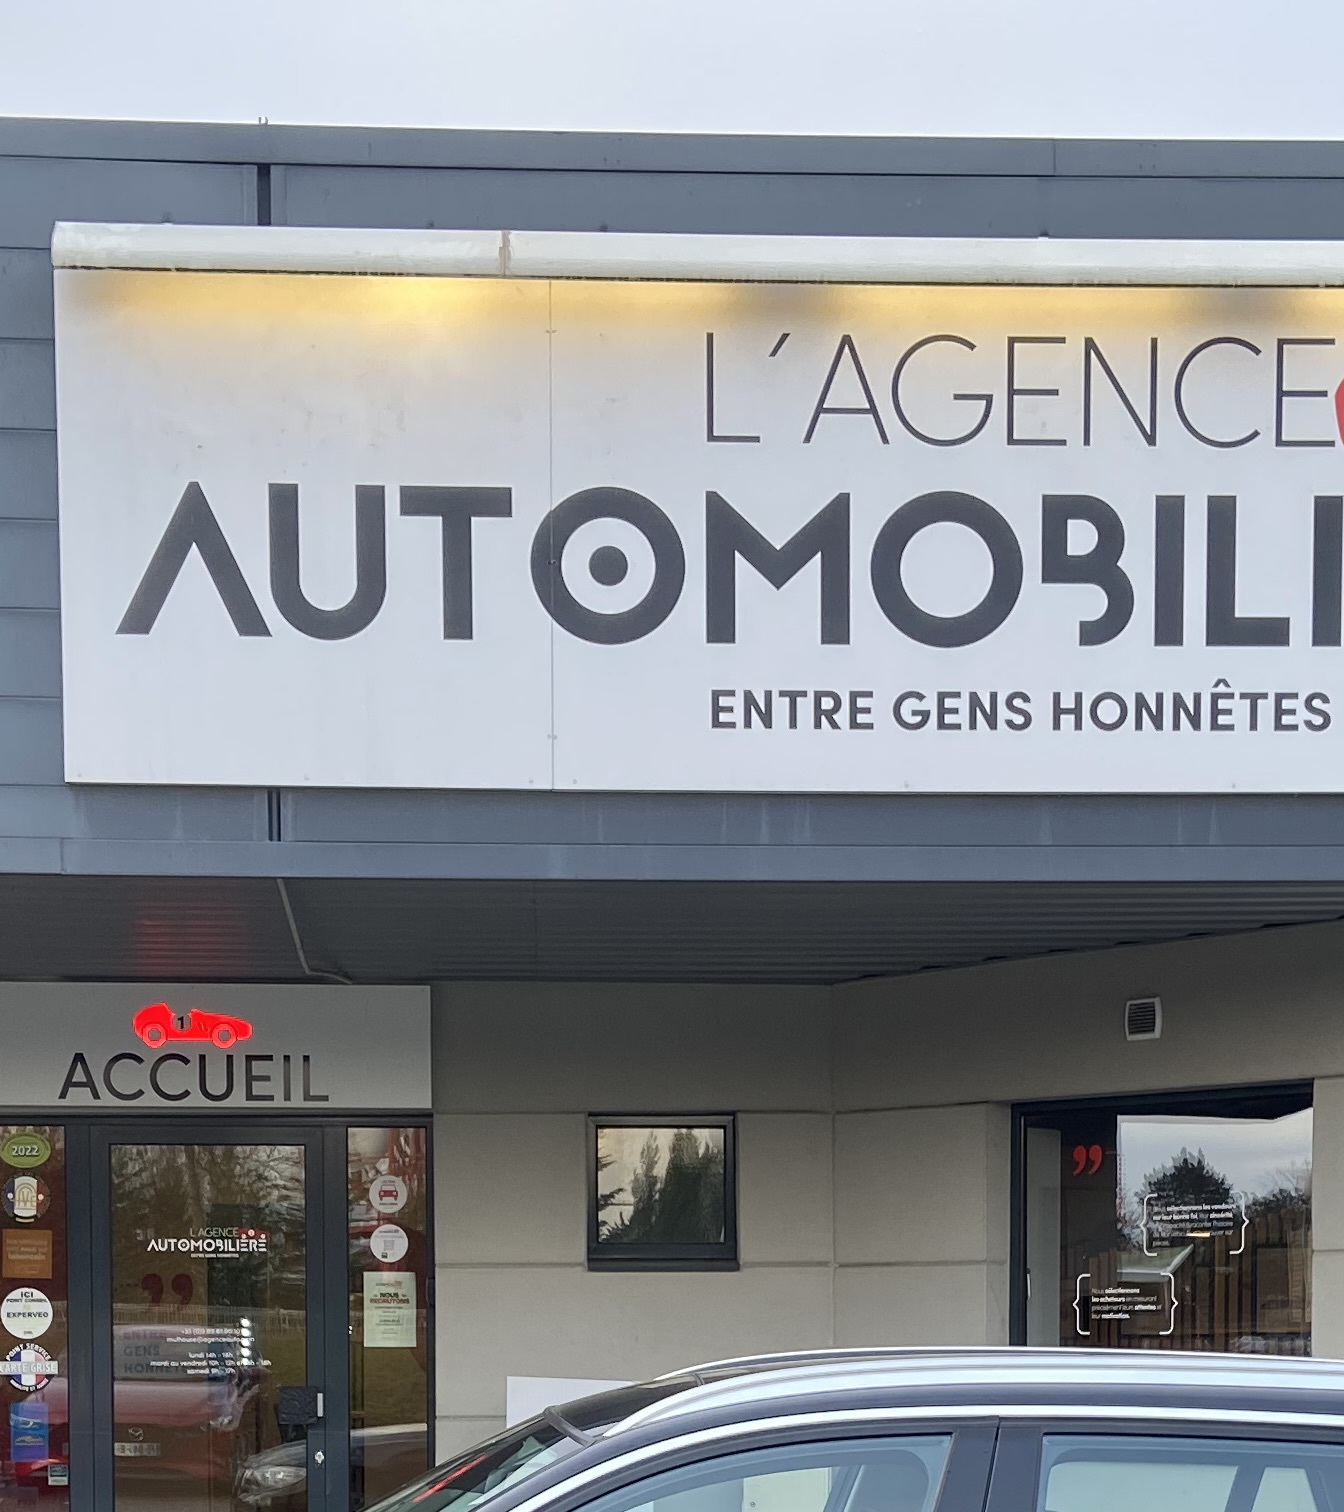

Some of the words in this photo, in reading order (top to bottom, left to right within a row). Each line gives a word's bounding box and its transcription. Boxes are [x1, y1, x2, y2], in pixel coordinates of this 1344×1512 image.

[705, 331, 1338, 449] L'AGENCE
[710, 689, 875, 732] ENTRE
[892, 690, 1034, 733] GENS
[1052, 678, 1333, 734] HONNÊTES
[57, 1051, 331, 1103] ACCUEIL
[11, 1145, 40, 1156] 2022
[20, 1291, 34, 1299] ICI
[30, 1362, 56, 1373] GRISE
